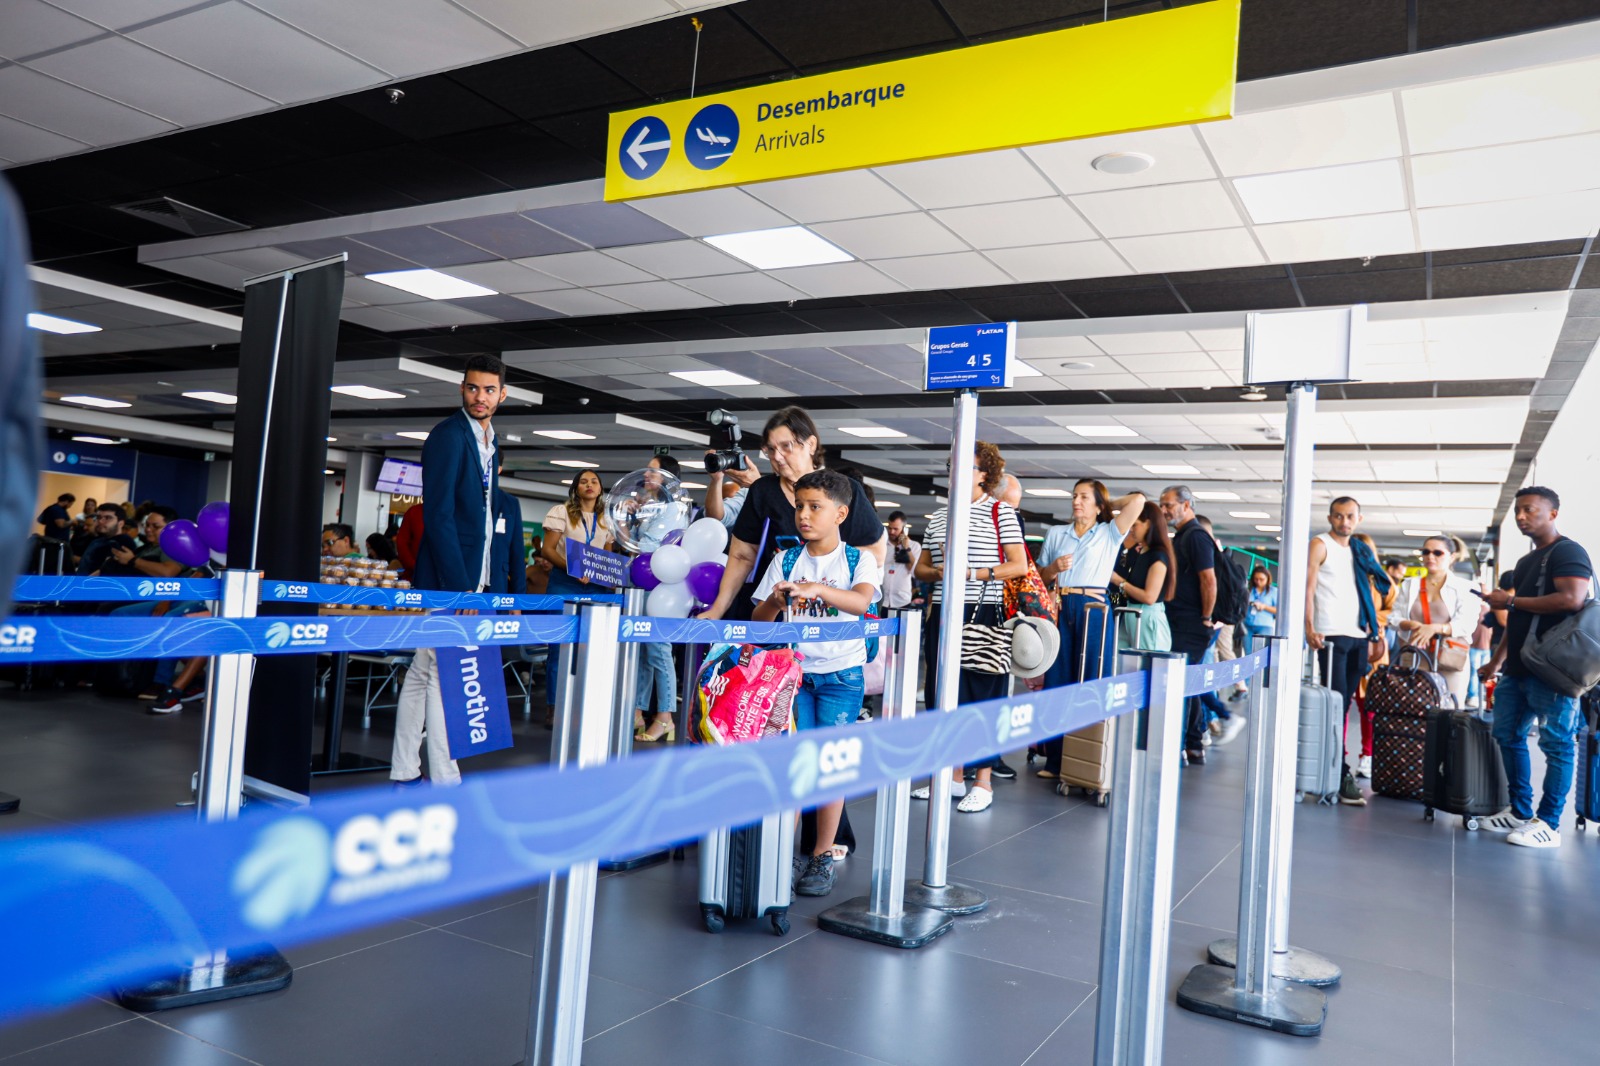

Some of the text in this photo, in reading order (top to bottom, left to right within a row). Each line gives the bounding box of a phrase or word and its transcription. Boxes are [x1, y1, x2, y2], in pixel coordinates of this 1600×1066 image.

[757, 83, 905, 122] Desembarque
[754, 124, 825, 153] Arrivals
[967, 354, 992, 367] 4 5
[582, 548, 622, 566] Lançamento
[582, 558, 623, 576] de nova rota!
[155, 581, 181, 591] CCR
[595, 572, 623, 586] motiva
[288, 585, 309, 595] CCR
[405, 592, 422, 601] CCR
[0, 625, 37, 645] CR
[291, 623, 329, 639] CCR
[494, 620, 520, 633] CCR
[633, 621, 652, 632] CCR
[732, 625, 747, 635] CCR
[460, 656, 490, 744] motiva
[739, 707, 759, 739] WASTE
[820, 736, 863, 774] CCR
[333, 803, 459, 878] CCR
